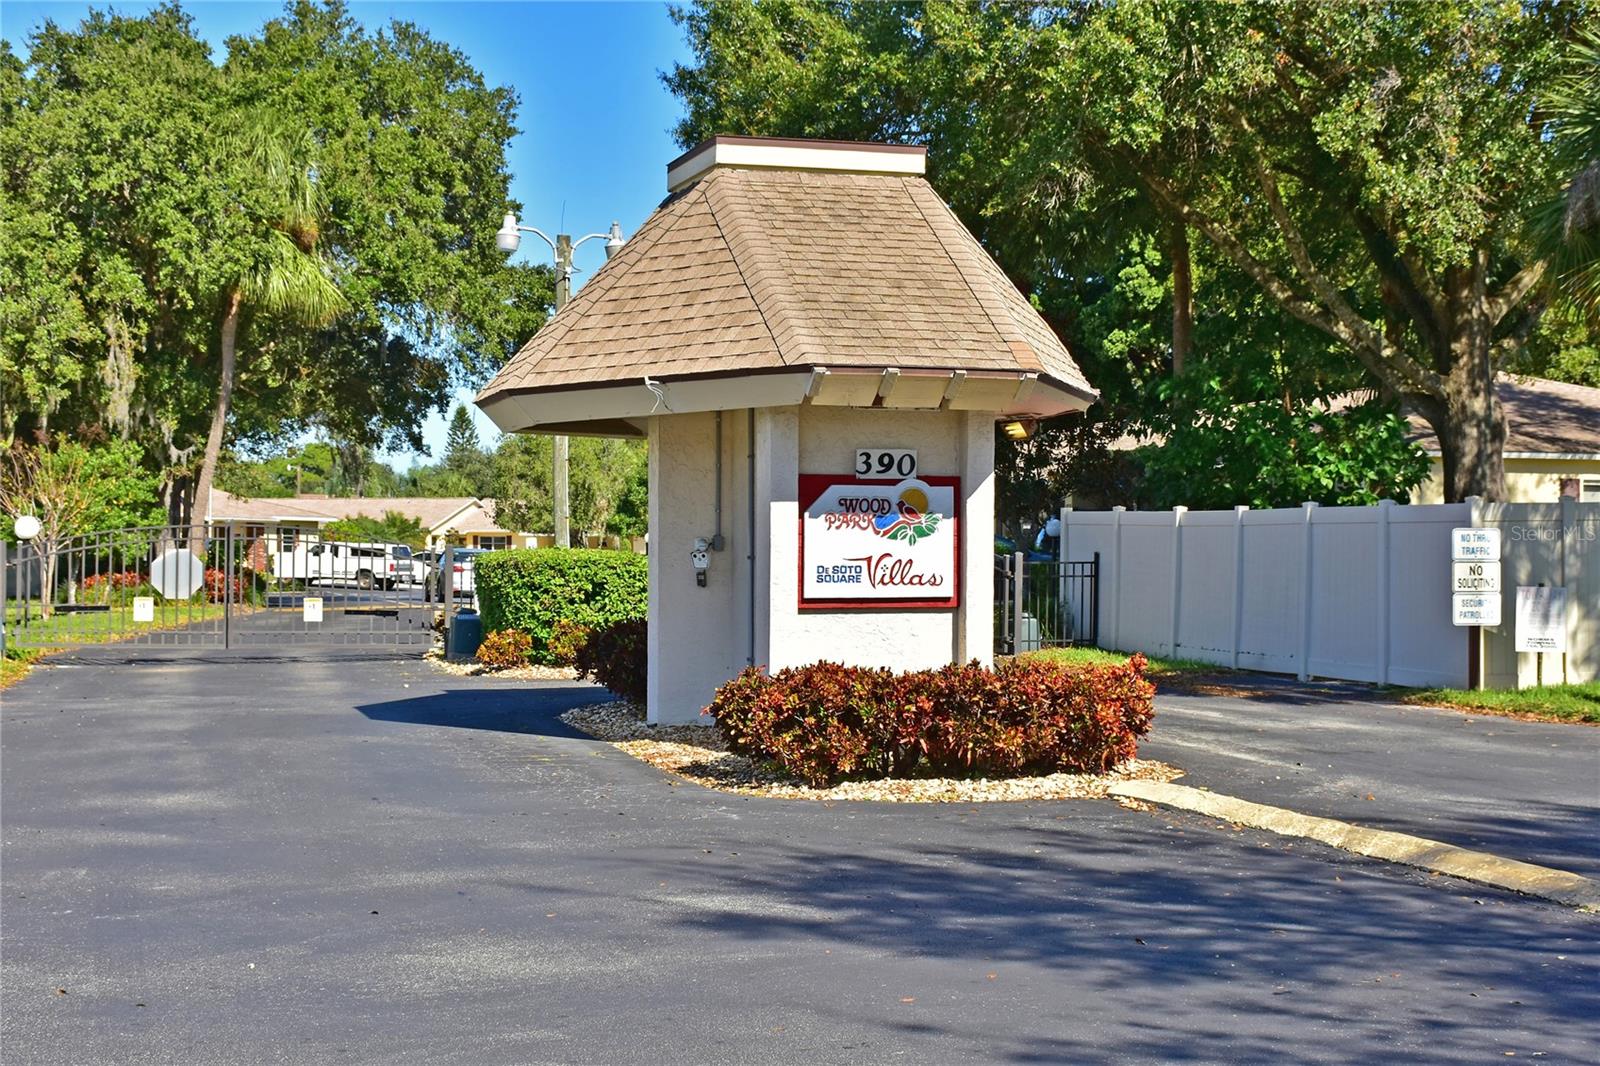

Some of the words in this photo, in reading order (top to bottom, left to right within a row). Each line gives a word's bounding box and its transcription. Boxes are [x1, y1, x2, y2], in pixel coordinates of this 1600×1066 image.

[855, 451, 916, 477] 390
[838, 498, 892, 515] WOOD
[825, 511, 881, 535] PARK
[1460, 533, 1471, 543] NO
[831, 565, 862, 574] SOTO
[842, 552, 944, 589] Villas
[1469, 565, 1483, 576] NO
[816, 574, 862, 583] SQUARE
[1461, 599, 1491, 608] SECURI
[1459, 610, 1494, 620] PATROL
